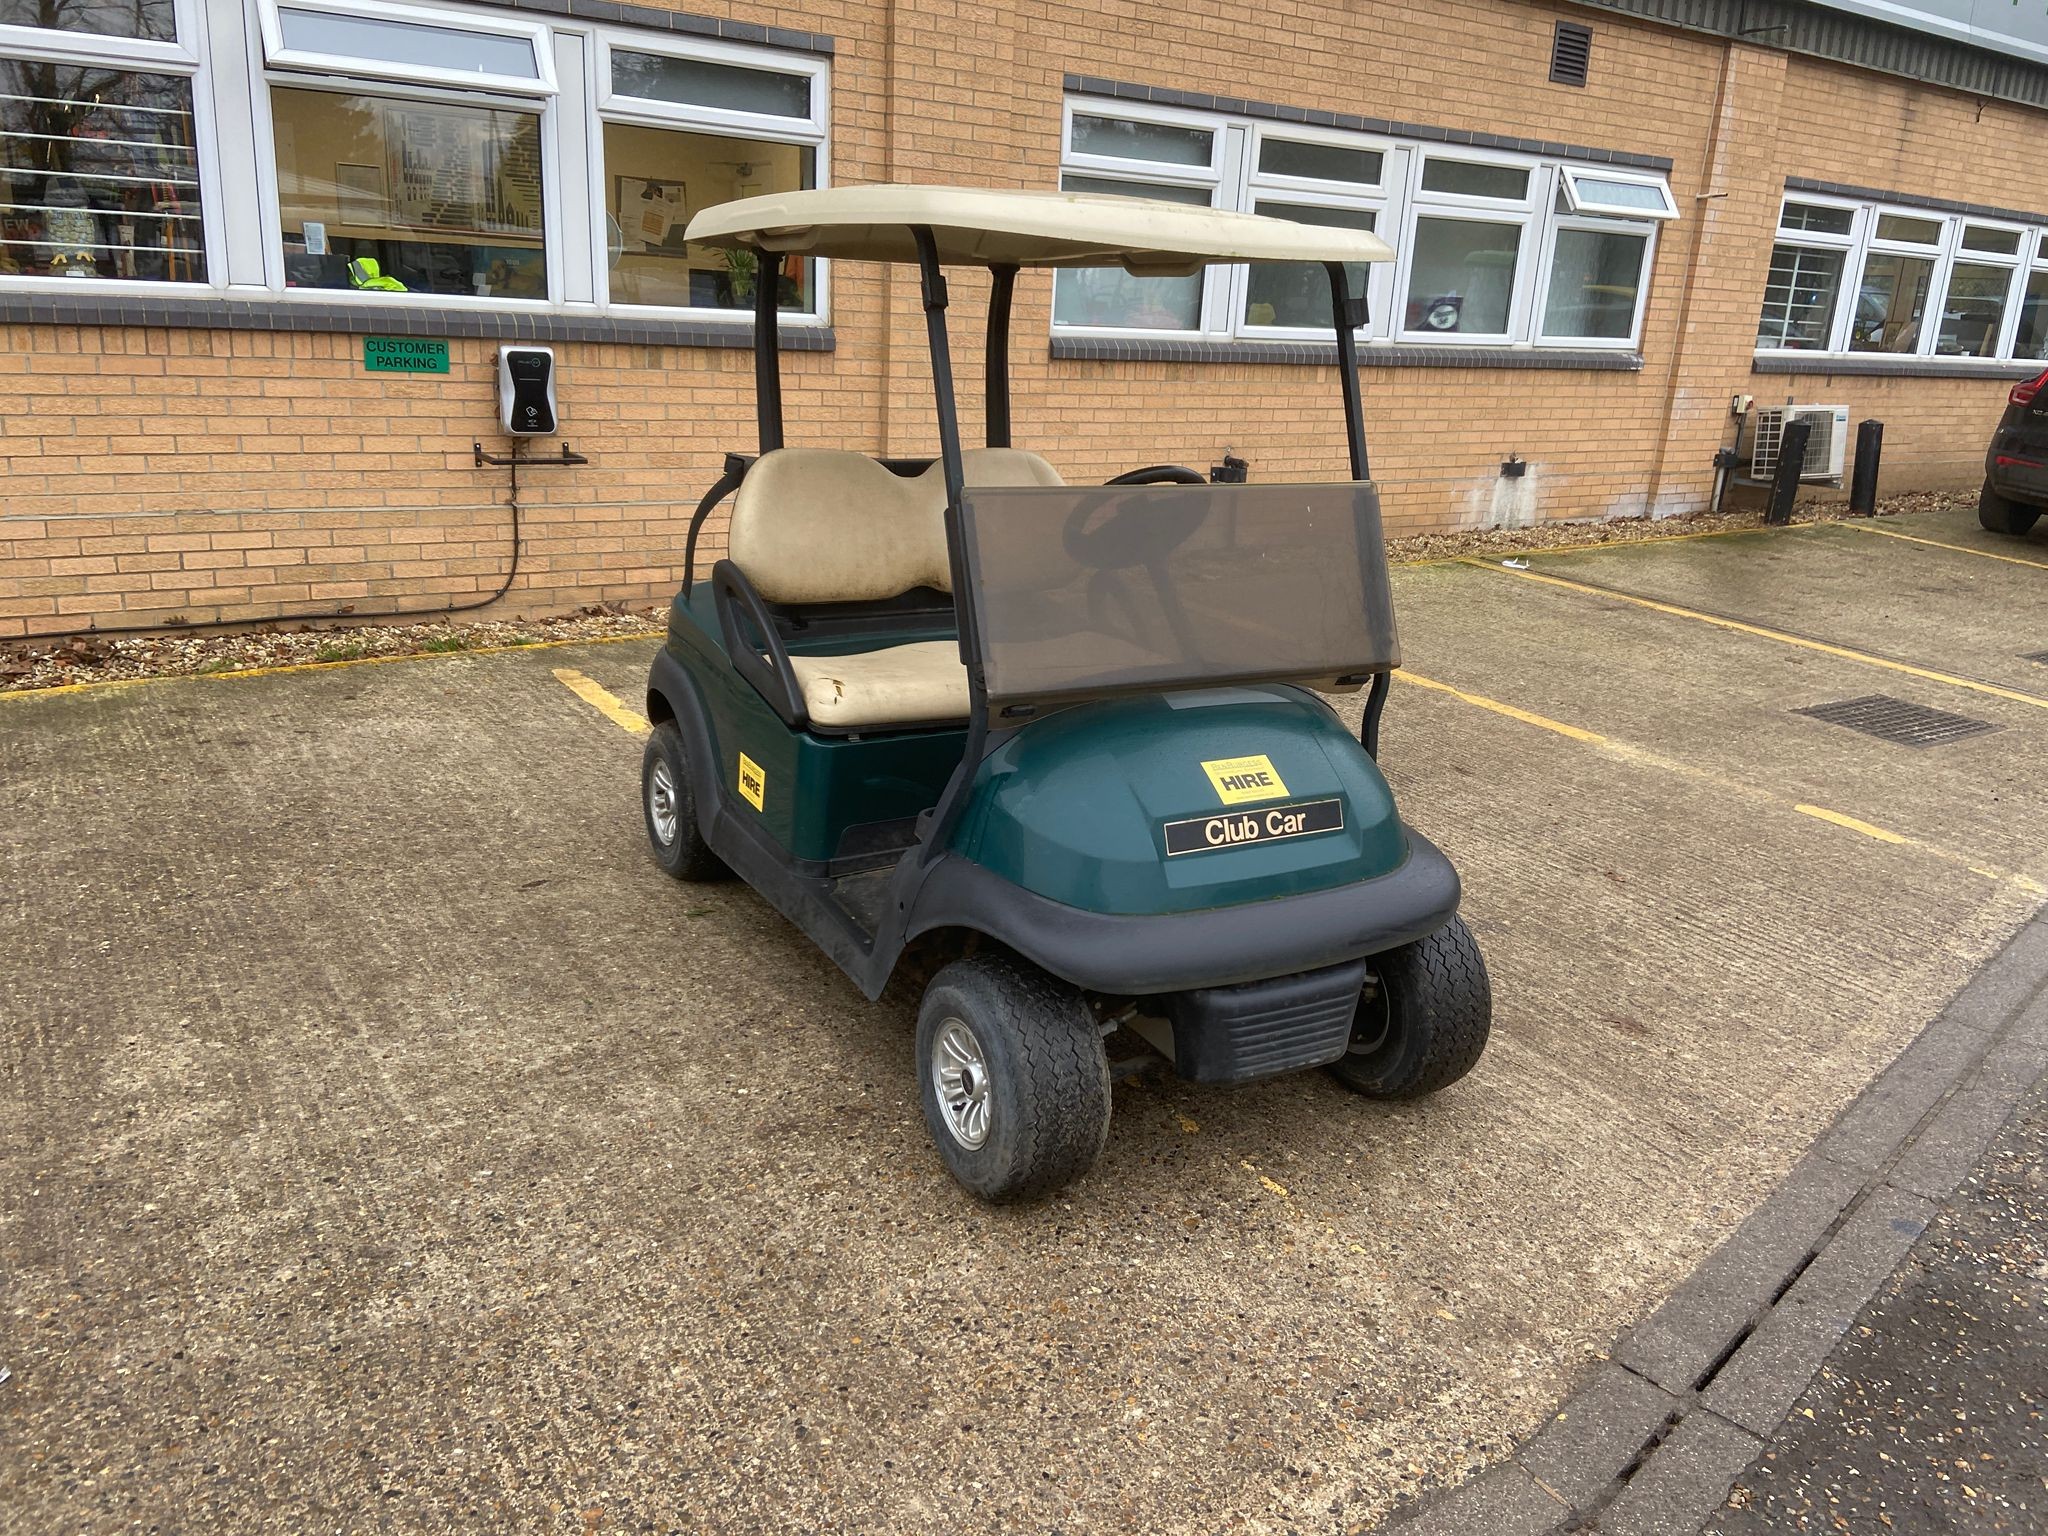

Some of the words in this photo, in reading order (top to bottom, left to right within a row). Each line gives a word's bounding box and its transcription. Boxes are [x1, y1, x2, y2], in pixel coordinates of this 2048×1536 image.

[366, 340, 445, 354] CUSTOMER
[376, 356, 437, 369] PARKING
[742, 770, 761, 798] HIRE
[1220, 771, 1274, 791] HIRE
[1205, 816, 1259, 845] Club
[1265, 811, 1306, 835] Car
